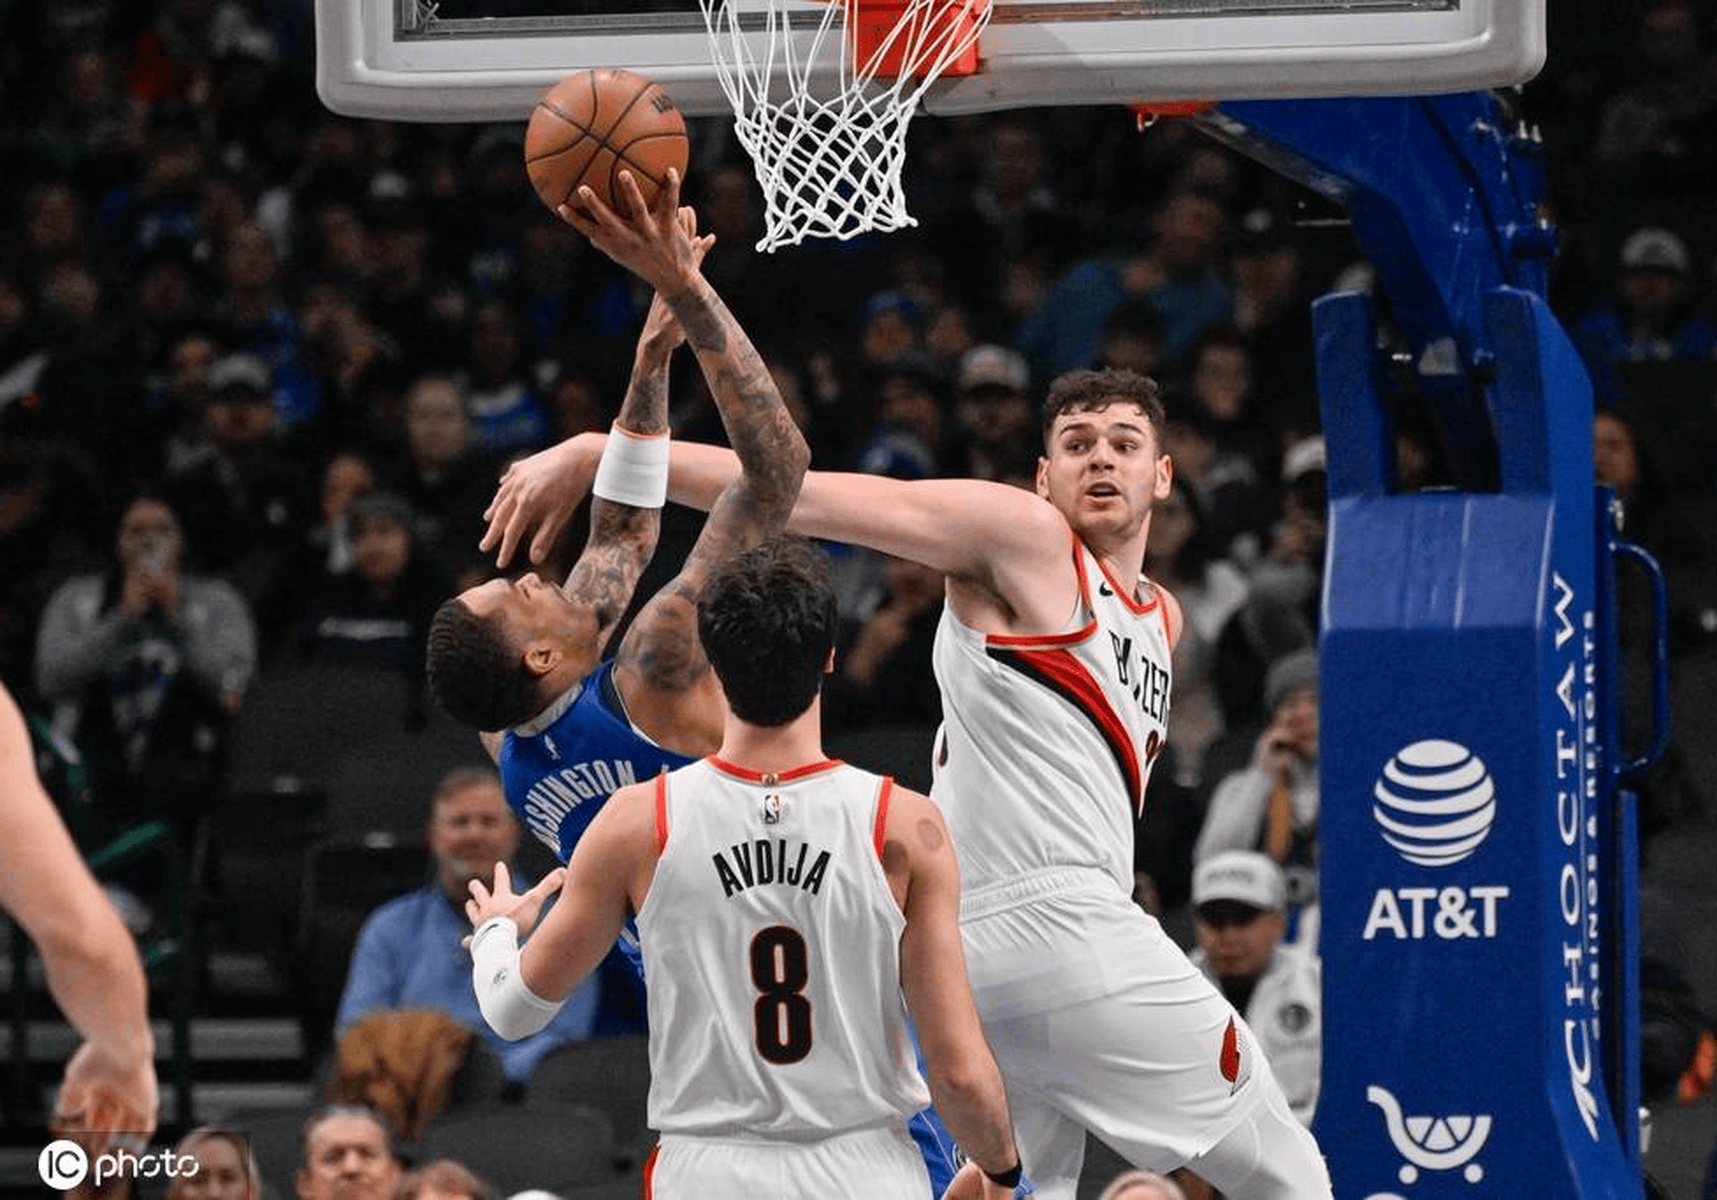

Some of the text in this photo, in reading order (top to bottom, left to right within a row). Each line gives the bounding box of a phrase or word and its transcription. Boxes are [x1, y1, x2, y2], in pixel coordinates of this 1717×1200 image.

[712, 838, 831, 898] AVDIJA
[1552, 571, 1592, 1088] CHOCTAW
[1362, 886, 1510, 940] AT&T
[750, 925, 813, 1065] 8
